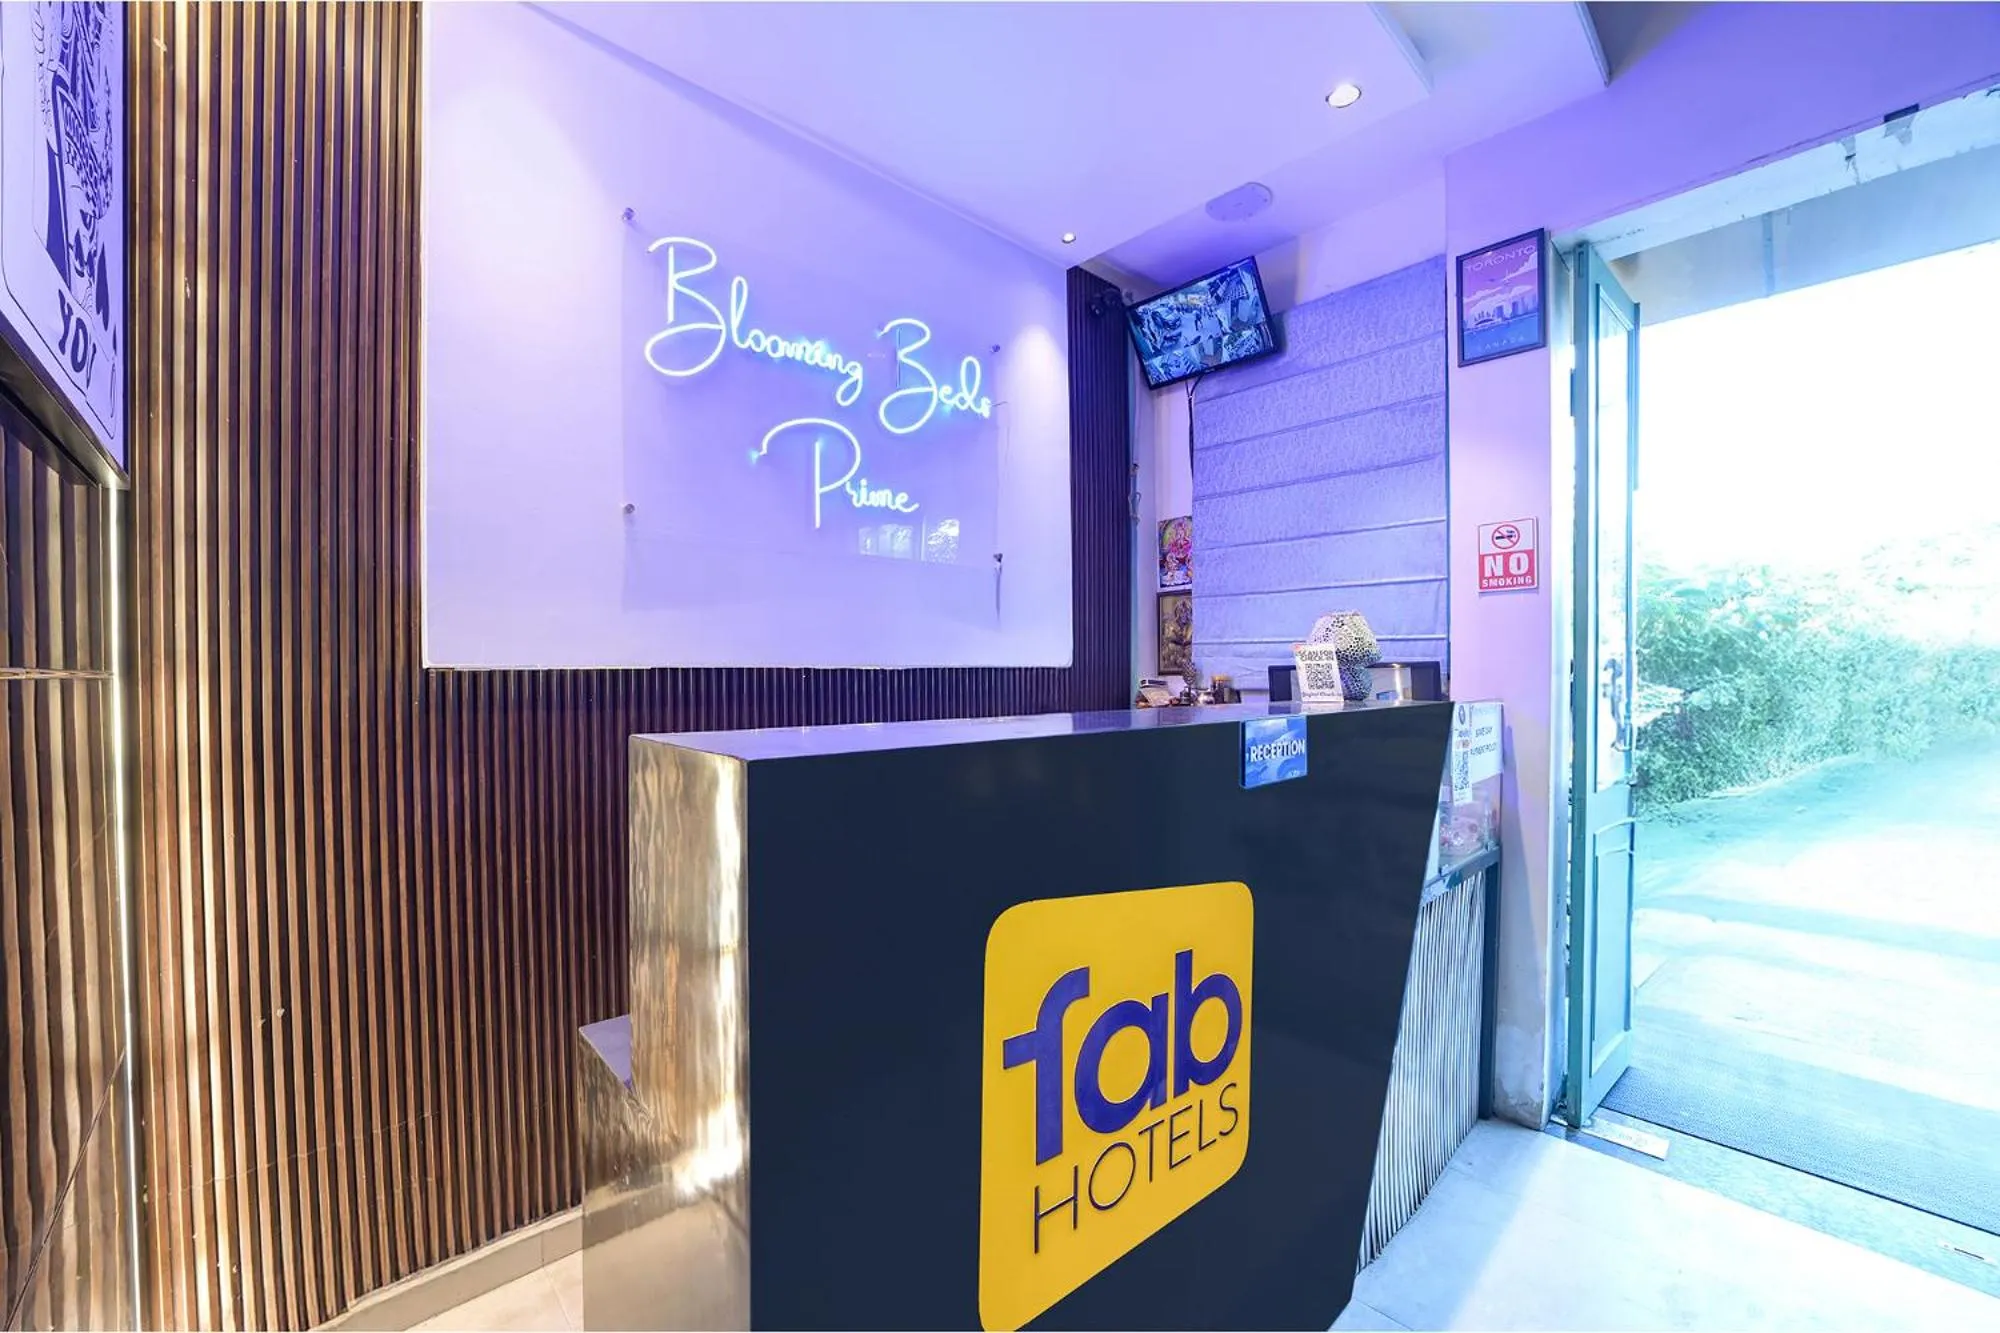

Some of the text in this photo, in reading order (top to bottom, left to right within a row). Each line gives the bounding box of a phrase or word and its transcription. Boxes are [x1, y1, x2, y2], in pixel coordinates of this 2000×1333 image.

[1463, 243, 1536, 273] TORONTO
[645, 236, 990, 434] Blooming Beds
[1477, 335, 1526, 354] ANADA
[756, 417, 919, 529] Prime
[1483, 552, 1529, 578] NO
[1482, 576, 1532, 588] SMOKING
[1250, 739, 1305, 763] RECEPTION
[1003, 949, 1243, 1167] fab
[1032, 1083, 1240, 1255] HOTELS
